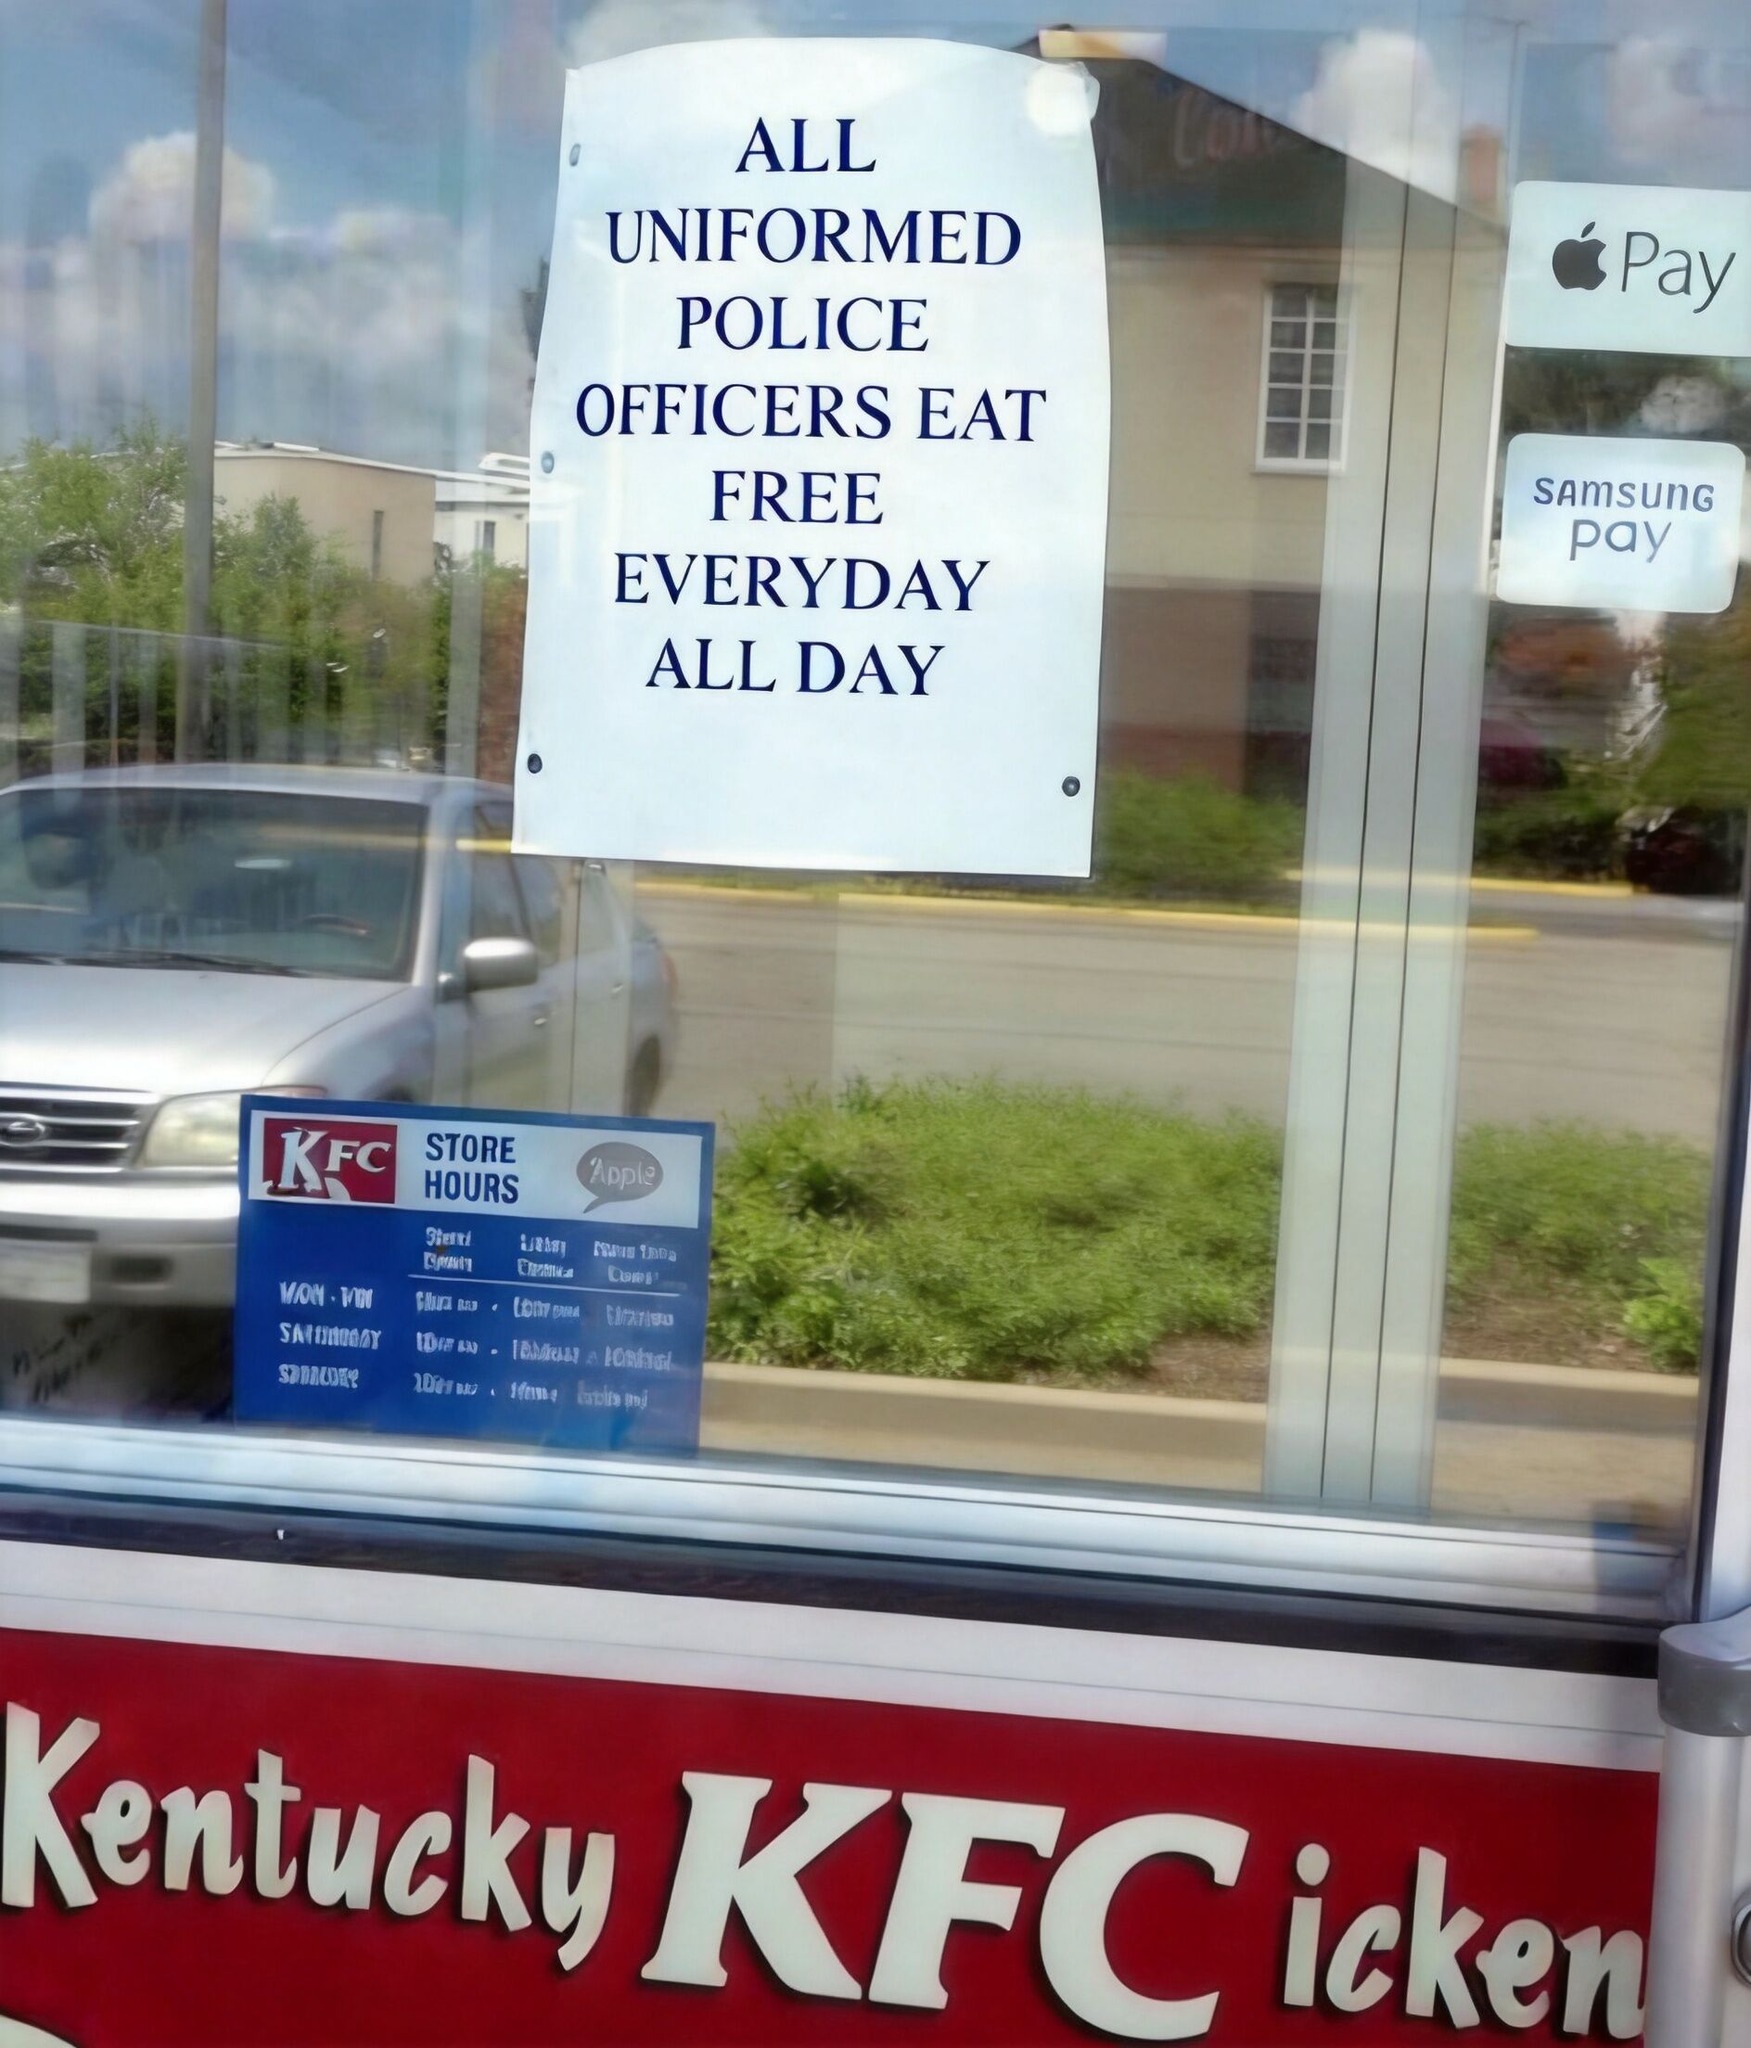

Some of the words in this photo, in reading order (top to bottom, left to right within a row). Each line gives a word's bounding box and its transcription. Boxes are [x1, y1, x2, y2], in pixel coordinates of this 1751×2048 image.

[735, 117, 876, 172] ALL
[606, 208, 1021, 265] UNIFORMED
[1622, 232, 1736, 313] Pay
[677, 296, 929, 351] POLICE
[576, 384, 892, 439] OFFICERS
[916, 388, 1047, 441] EAT
[709, 471, 884, 524] FREE
[1570, 518, 1672, 562] pay
[615, 553, 990, 611] EVERYDAY
[646, 638, 776, 692] ALL
[796, 642, 945, 695] DAY
[280, 1127, 391, 1191] KFC
[425, 1132, 517, 1164] STORE
[424, 1169, 520, 1205] HOURS
[1, 1702, 615, 1971] Kentucky
[641, 1771, 1250, 2041] KFC
